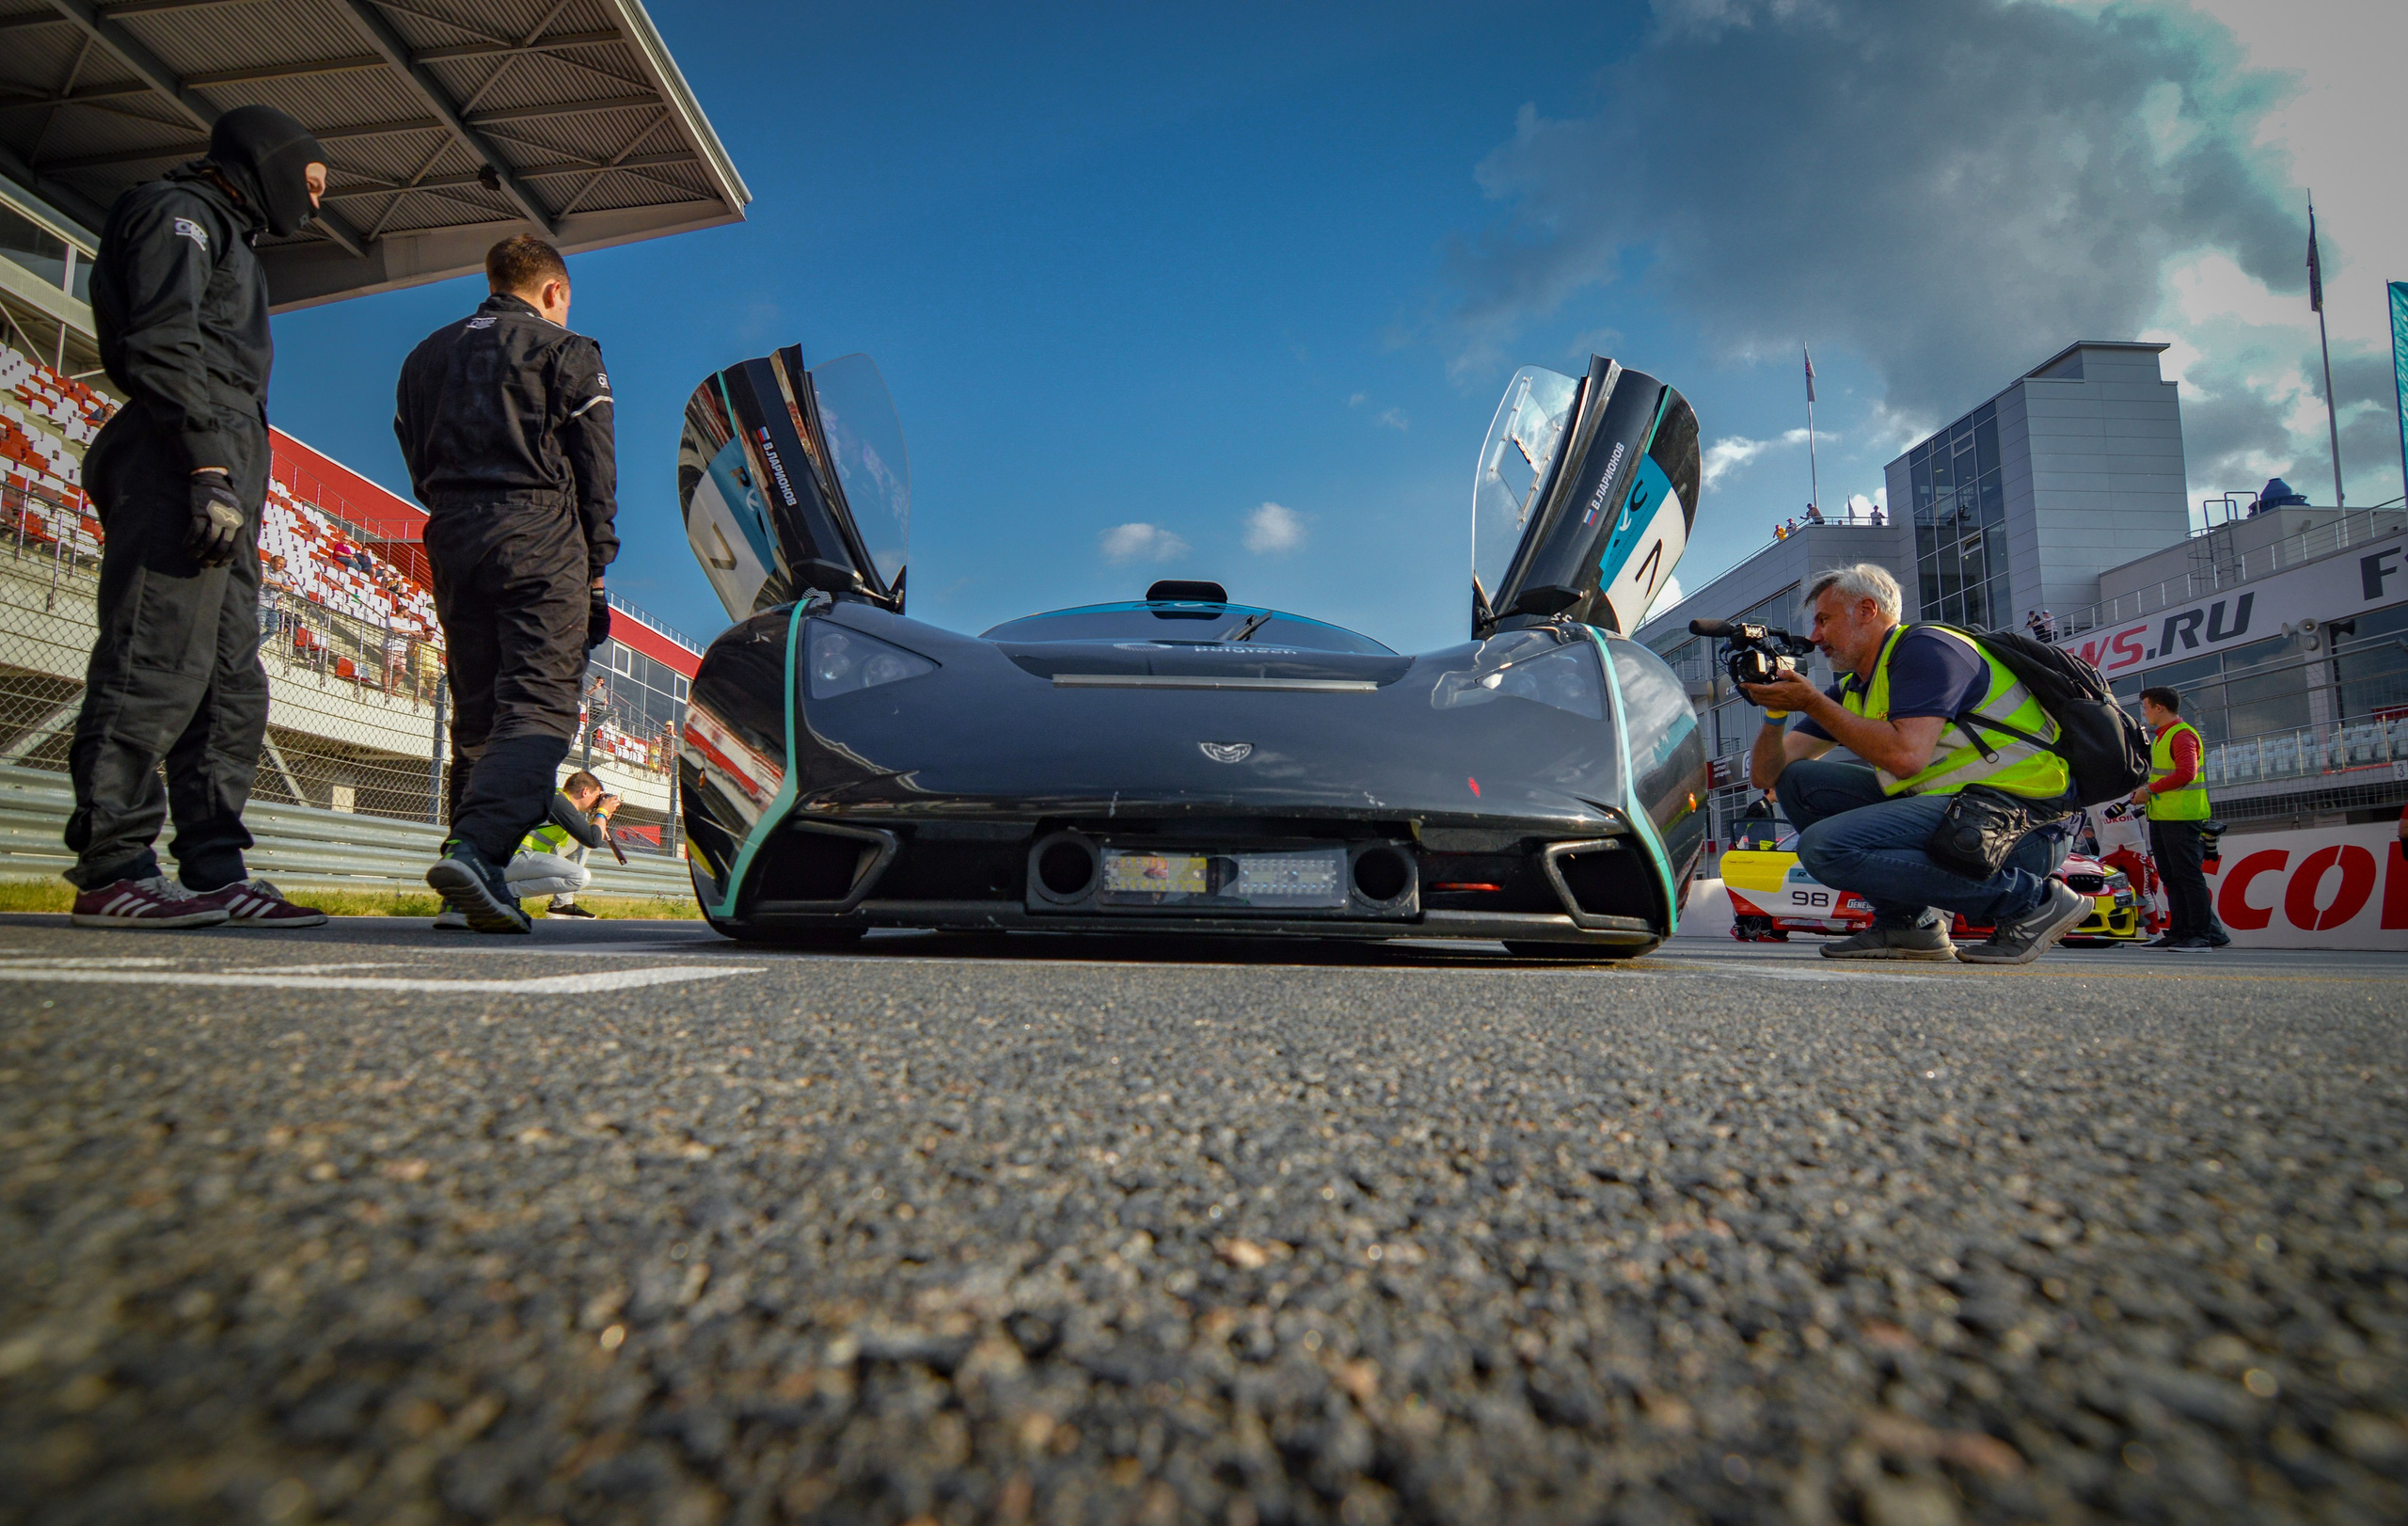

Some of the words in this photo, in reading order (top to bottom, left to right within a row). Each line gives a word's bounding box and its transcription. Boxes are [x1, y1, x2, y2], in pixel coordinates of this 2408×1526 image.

[763, 442, 798, 506] В.ЛАРИОНОВ
[1592, 442, 1625, 510] В.ЛАРИОНОВ
[2398, 763, 2405, 778] 3
[1792, 890, 1830, 908] 98
